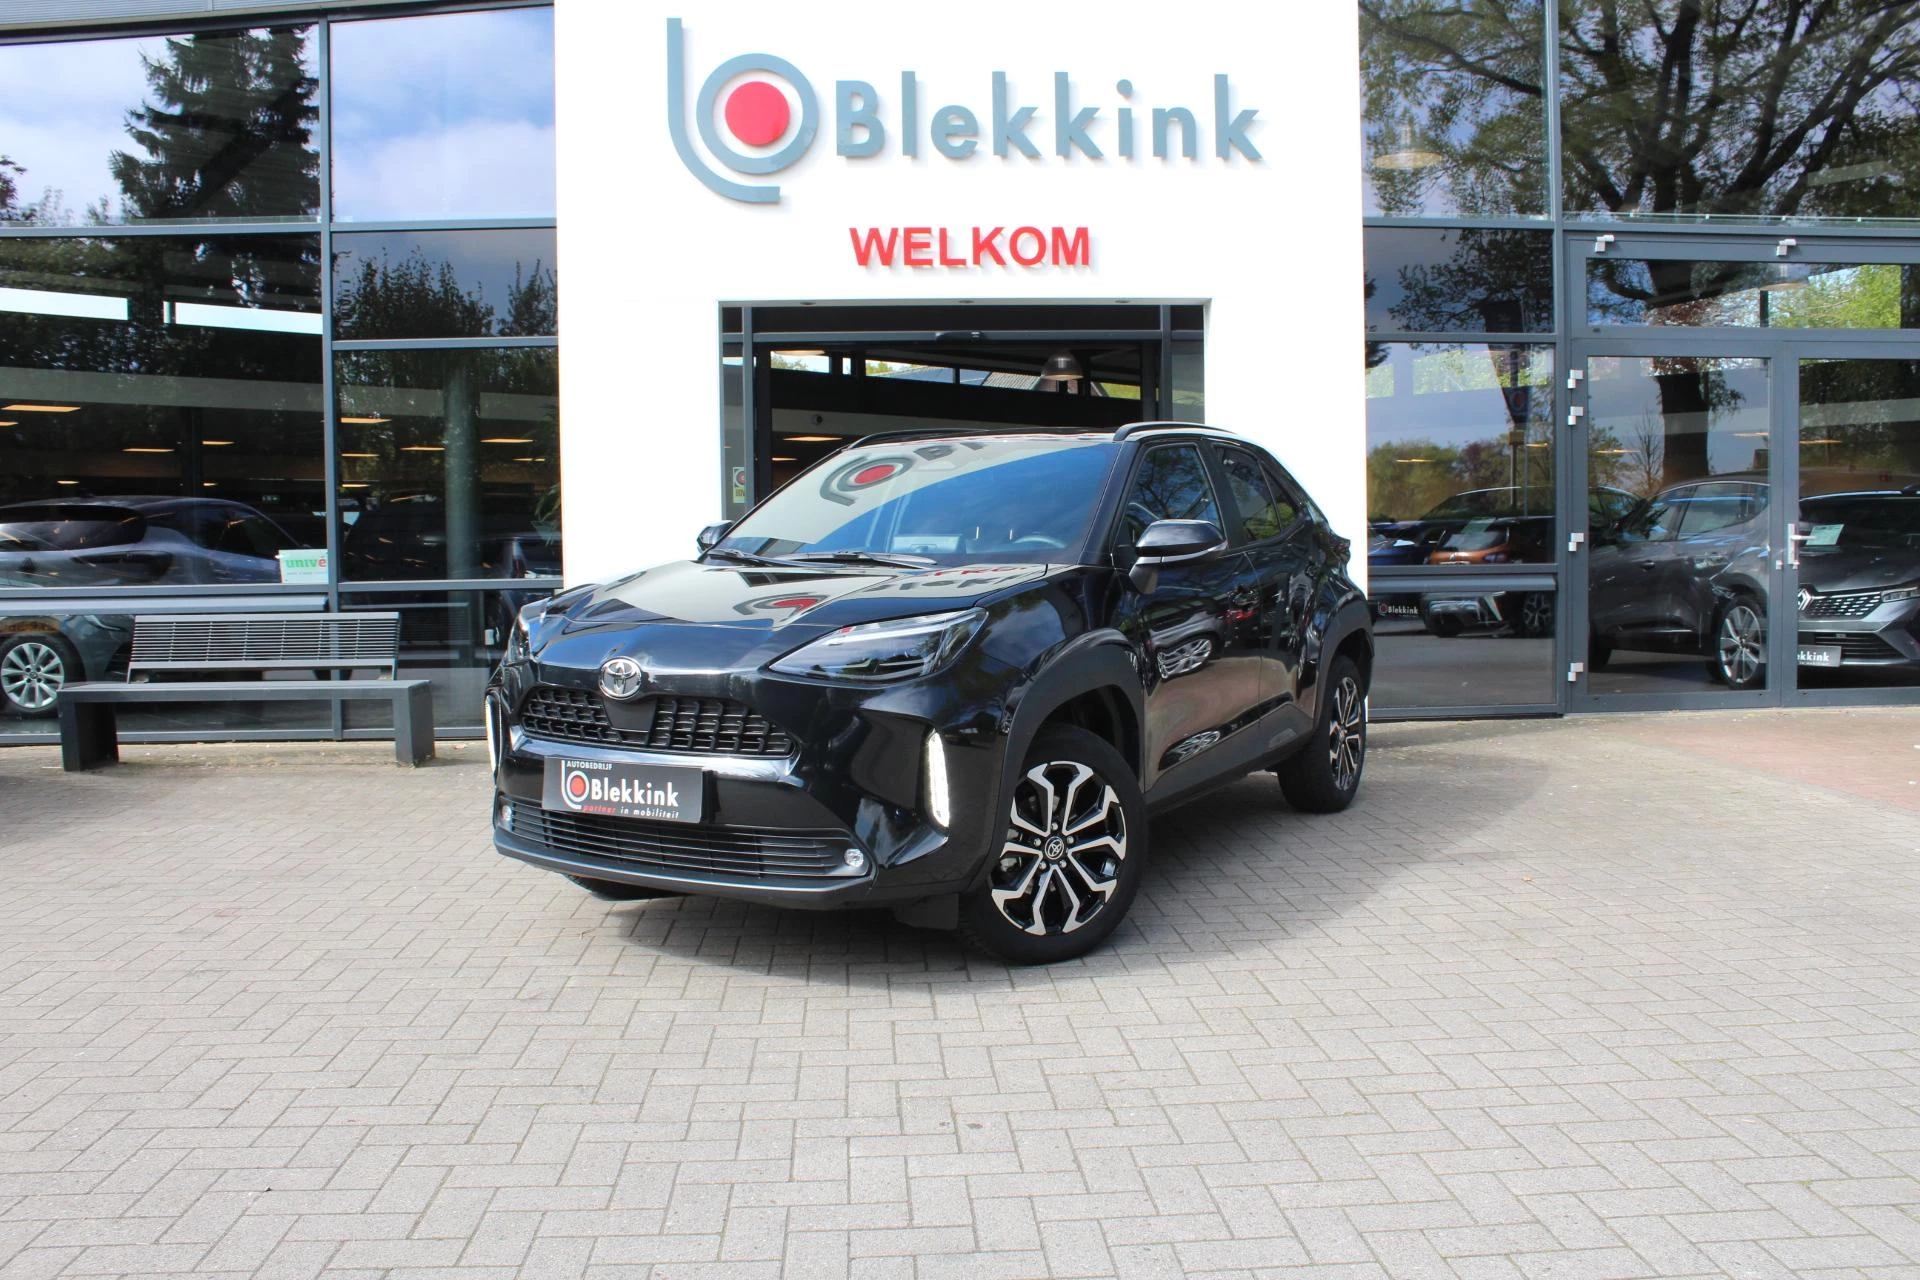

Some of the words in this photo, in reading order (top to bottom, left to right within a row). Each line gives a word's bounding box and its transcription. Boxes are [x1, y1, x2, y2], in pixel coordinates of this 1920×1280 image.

[836, 71, 1263, 160] Blekkink
[849, 226, 1091, 267] WELKOM
[566, 760, 613, 771] AUTOBEDRIJF
[591, 777, 679, 807] Blekkink
[583, 804, 617, 814] partner
[620, 806, 629, 814] in
[633, 808, 680, 819] mobiliteit
